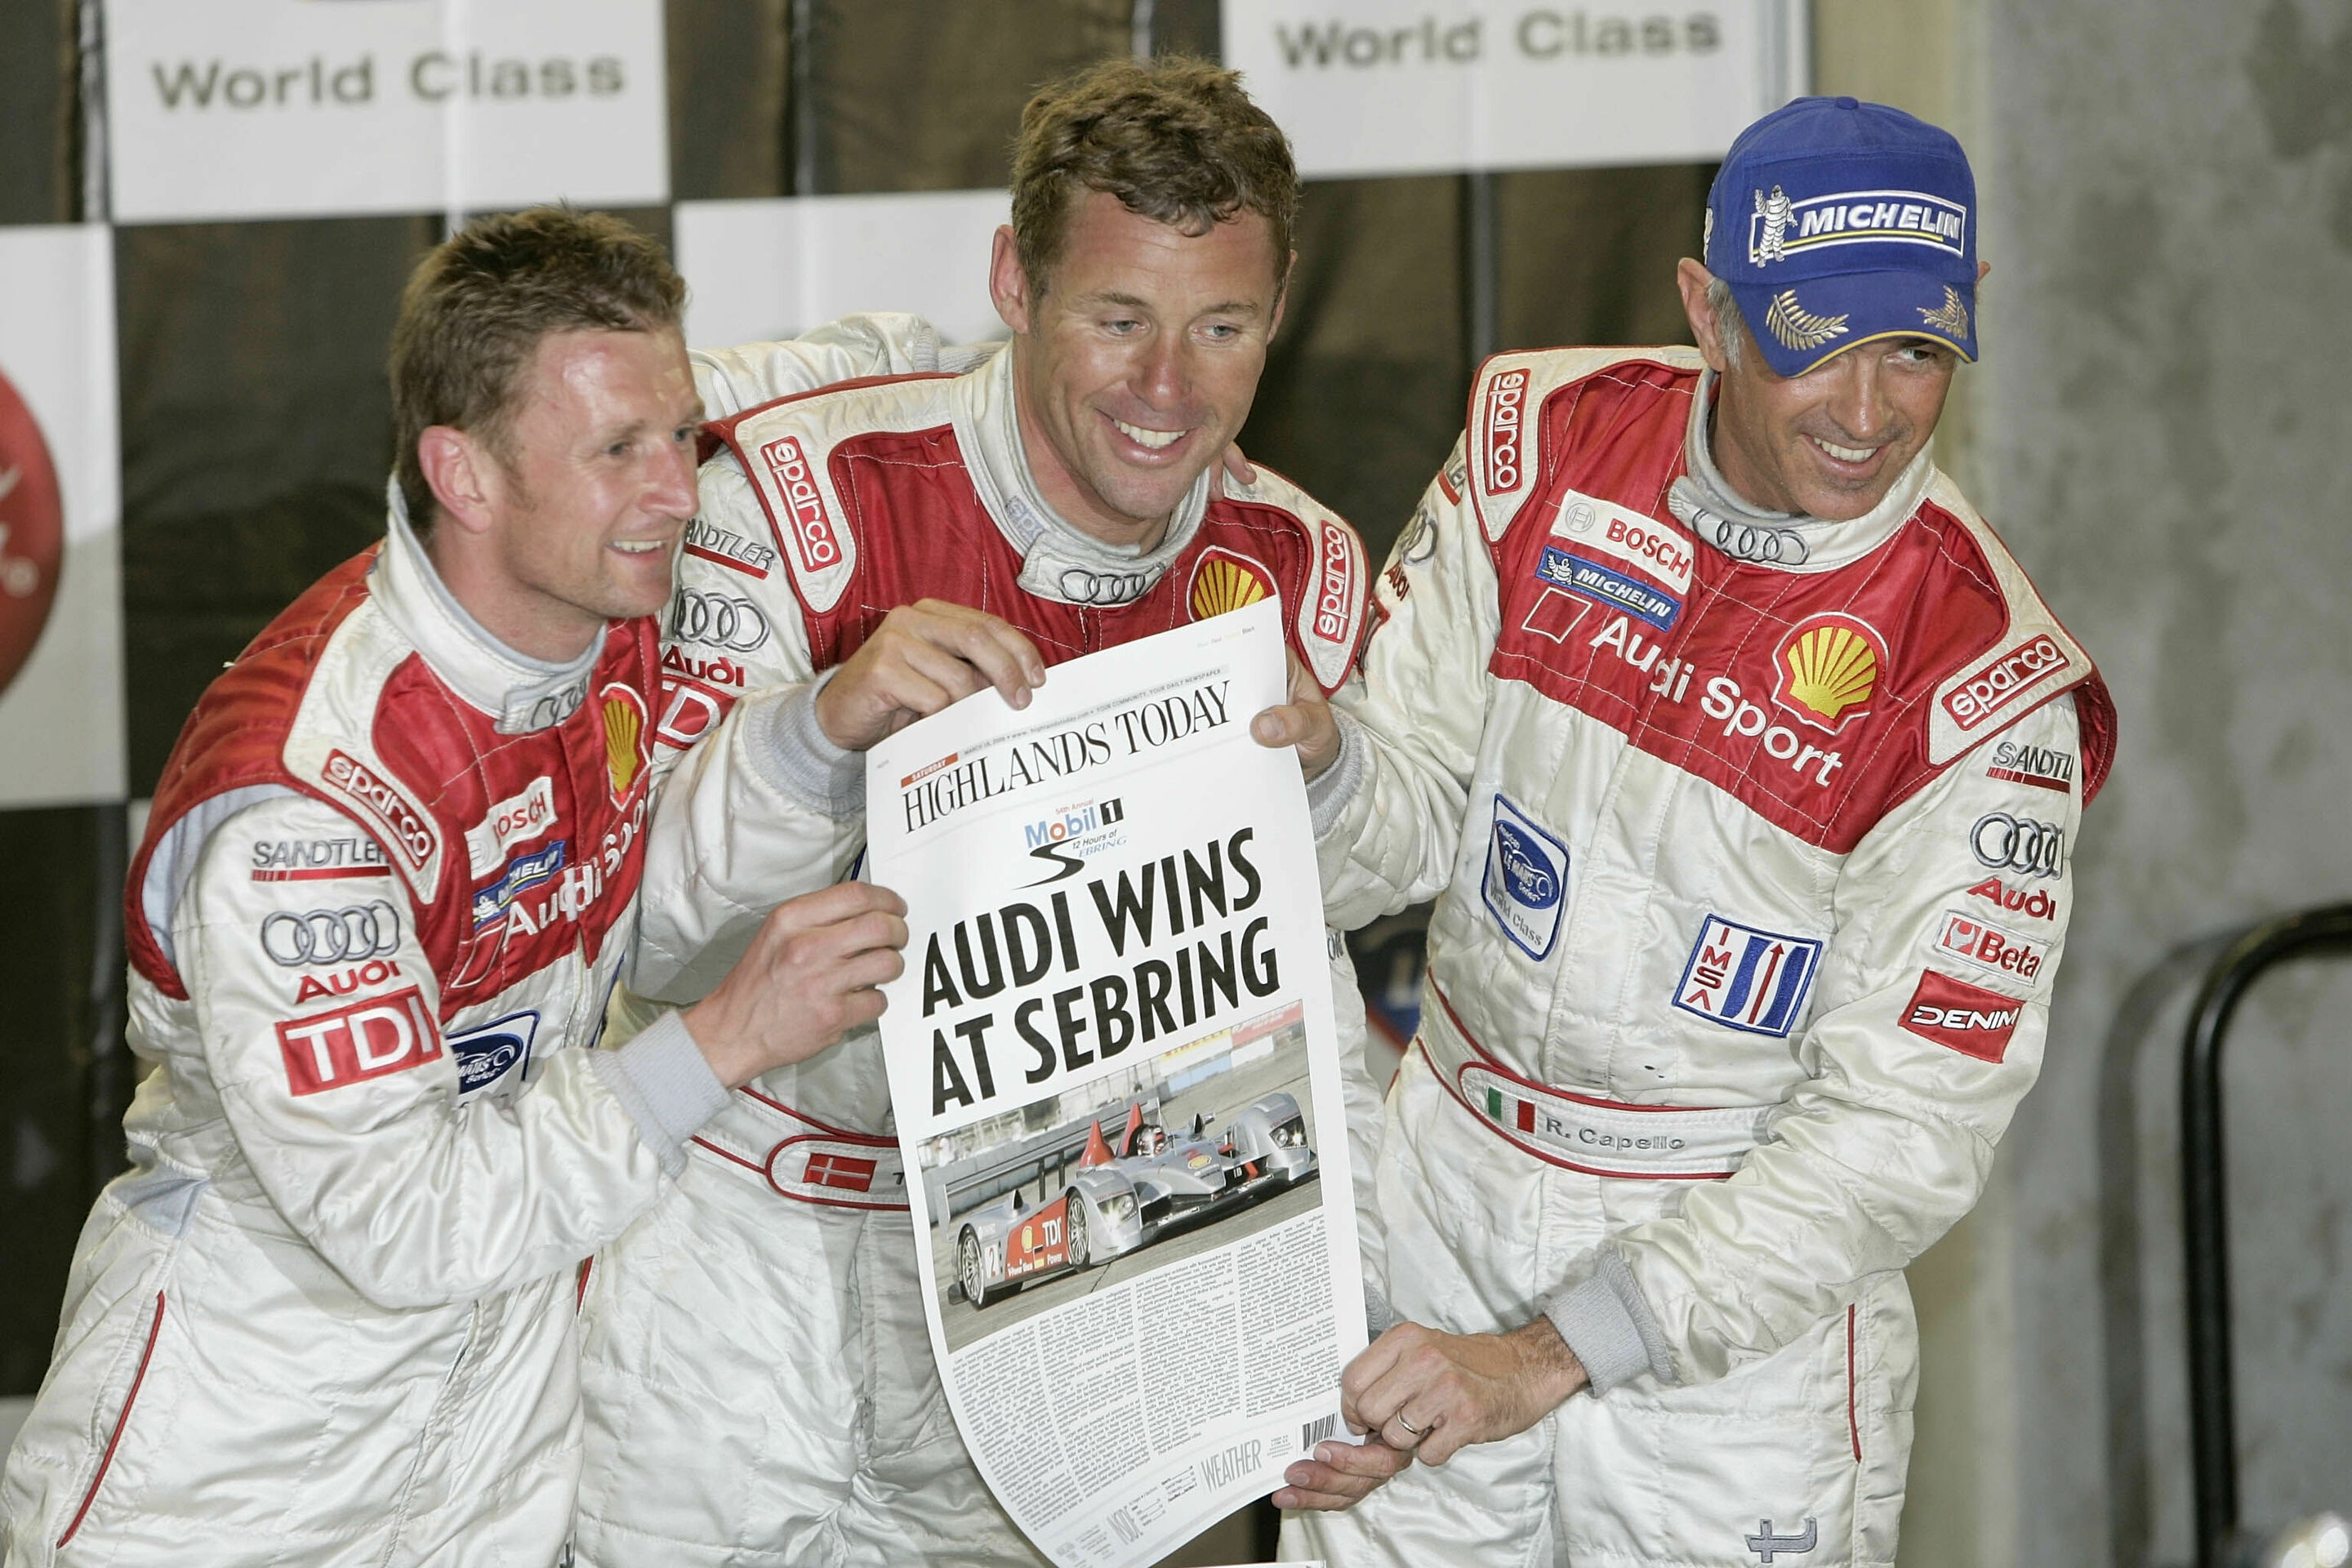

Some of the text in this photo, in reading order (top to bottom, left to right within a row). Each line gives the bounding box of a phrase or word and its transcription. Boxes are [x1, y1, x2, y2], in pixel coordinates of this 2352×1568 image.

[1276, 9, 1723, 69] World Class
[152, 50, 625, 109] World Class
[1798, 203, 1961, 240] MICHELIN
[1489, 372, 1525, 489] sparco
[773, 442, 835, 563] sparco
[685, 519, 775, 571] ANDTLER
[1605, 519, 1691, 580] BOSCH
[1317, 524, 1350, 637] sparco
[1574, 568, 1673, 619] MICHELIN
[1589, 617, 1843, 787] Audi Sport
[1951, 640, 2058, 716] sparco
[902, 680, 1232, 835] HIGHLANDS TODAY
[328, 756, 431, 858] sparco
[492, 791, 547, 846] OSCH
[1024, 806, 1097, 849] Mobil
[1072, 829, 1117, 849] 12 Hours of
[922, 826, 1262, 1018] AUDI WINS
[1512, 912, 1543, 947] Class
[1976, 930, 2041, 978] Beta
[285, 995, 434, 1082] TDI
[933, 916, 1281, 1117] AT SEBRING
[1910, 1005, 2020, 1030] DENIM
[1546, 1116, 1686, 1152] R. Capello
[1042, 1216, 1062, 1248] TDI
[1200, 1437, 1263, 1494] WEATHER
